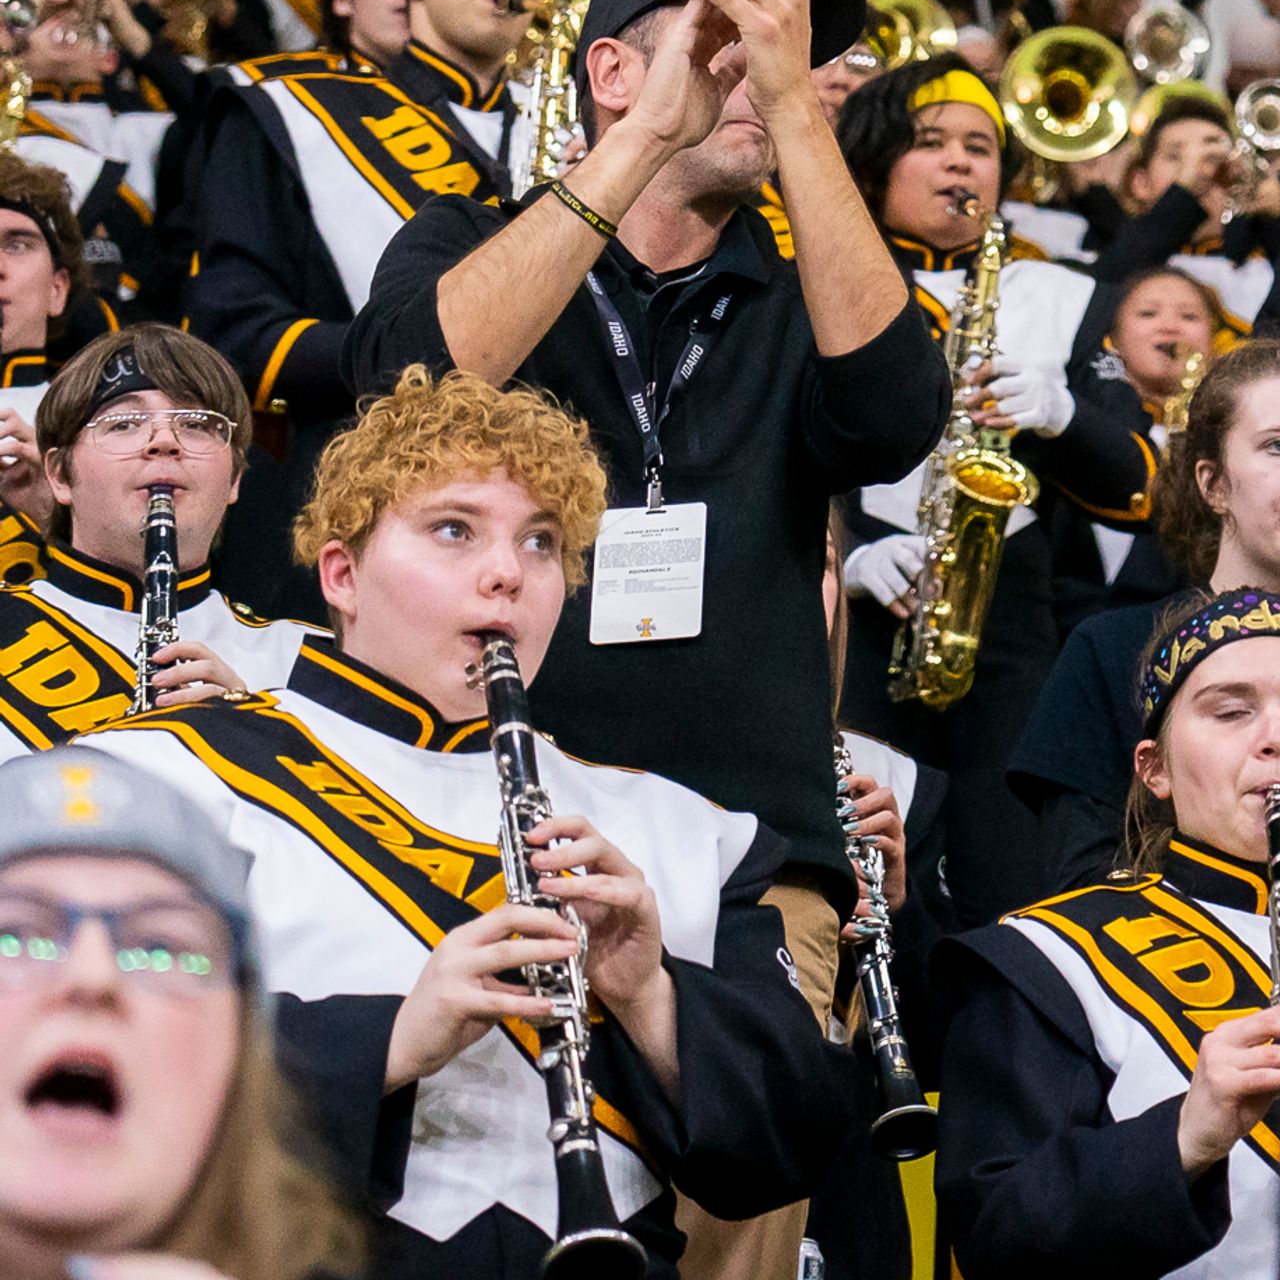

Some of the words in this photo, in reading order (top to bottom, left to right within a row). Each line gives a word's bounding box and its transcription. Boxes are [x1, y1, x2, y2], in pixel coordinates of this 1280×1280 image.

[361, 105, 500, 207] IDA
[608, 321, 629, 357] IDAHO
[680, 343, 704, 380] IDAHO
[631, 393, 651, 434] IDAHO
